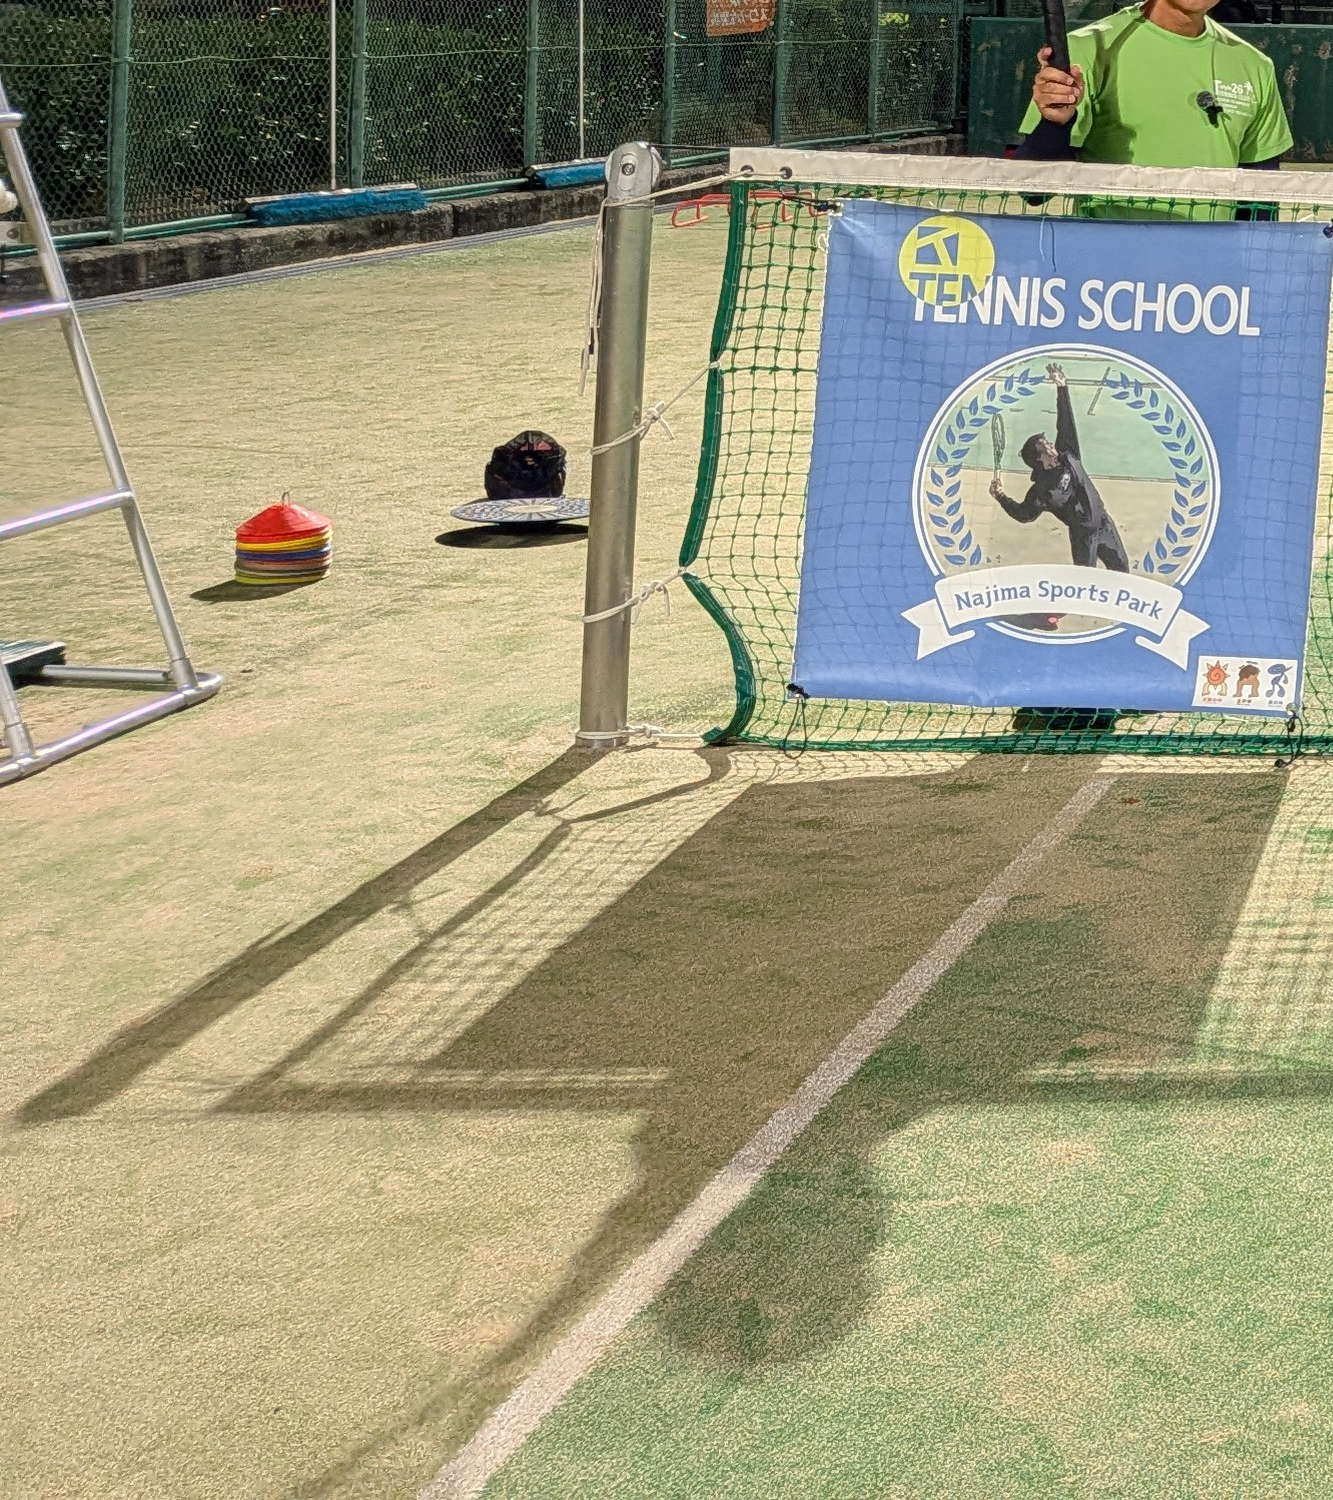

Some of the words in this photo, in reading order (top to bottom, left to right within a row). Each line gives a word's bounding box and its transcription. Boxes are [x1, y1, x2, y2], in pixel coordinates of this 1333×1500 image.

[908, 271, 1067, 329] TENNIS
[1077, 279, 1261, 337] SCHOOL
[953, 583, 1031, 611] Najima
[1037, 580, 1111, 604] Sports
[1114, 588, 1164, 620] Park
